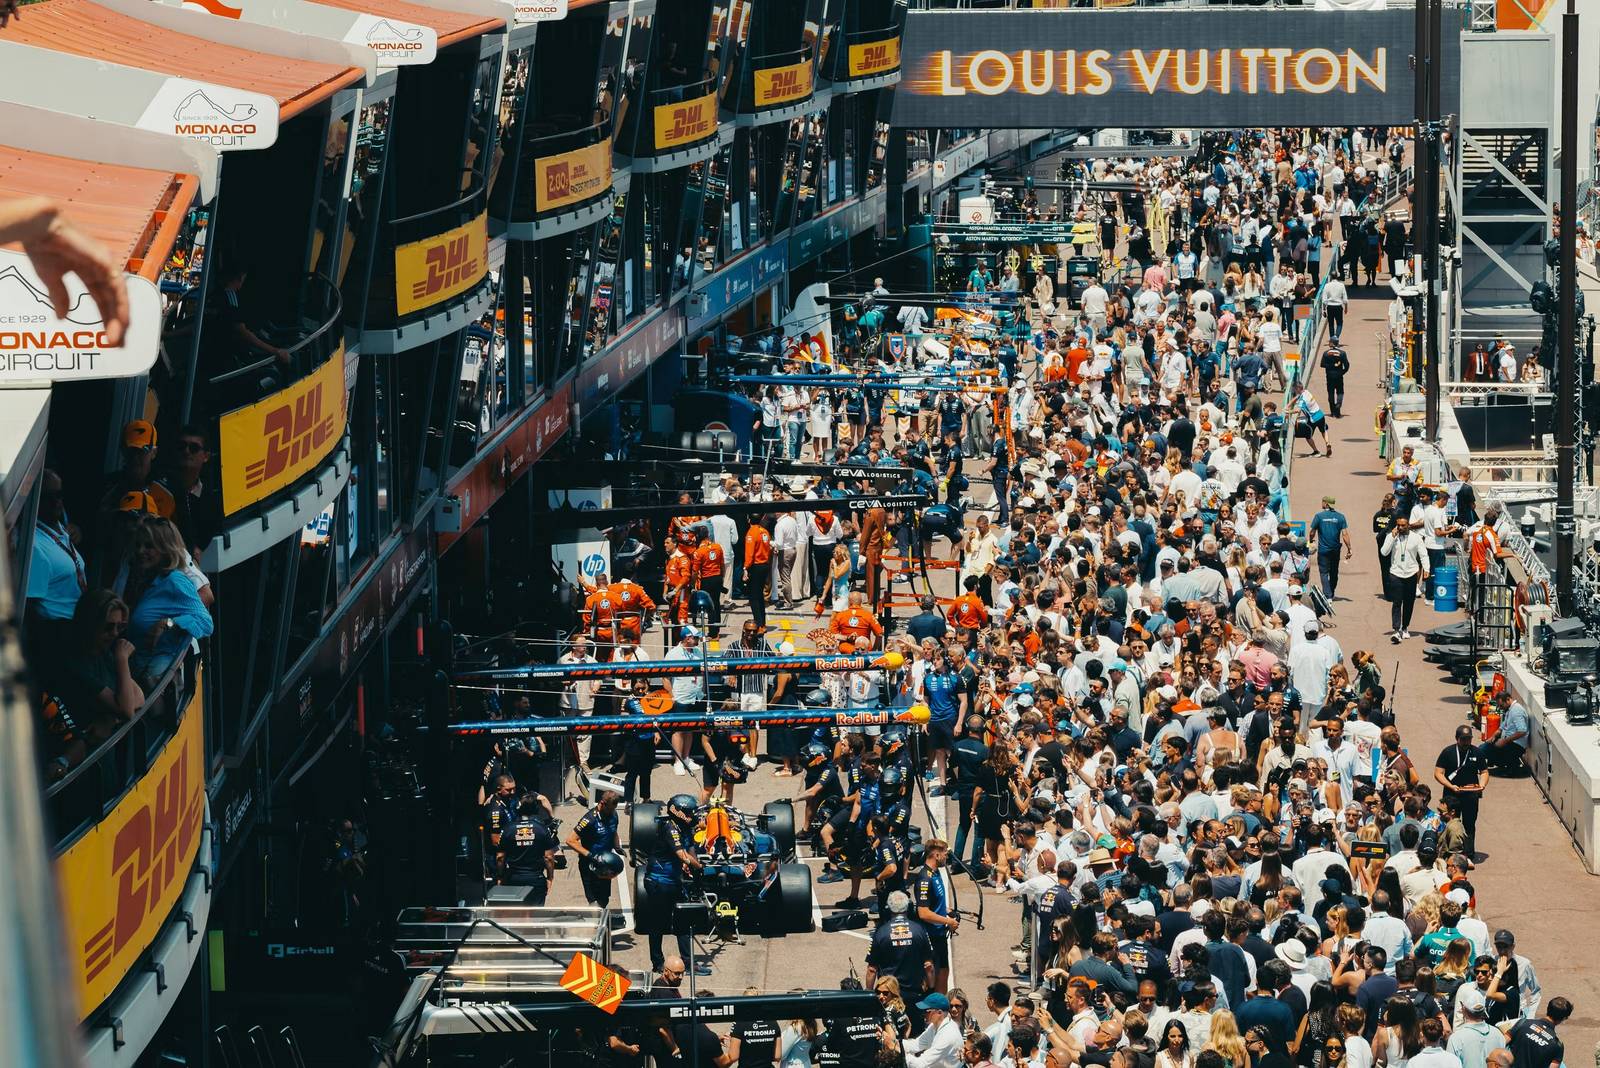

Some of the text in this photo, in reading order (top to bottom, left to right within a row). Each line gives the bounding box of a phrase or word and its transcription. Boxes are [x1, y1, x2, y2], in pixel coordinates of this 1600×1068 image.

[863, 45, 891, 70] DHL
[941, 47, 1387, 96] LOUIS VUITTON
[770, 70, 803, 99] DHL
[175, 124, 257, 135] MONACO
[672, 104, 709, 140] DHL
[188, 135, 247, 146] RCUIT
[425, 233, 478, 297] DHL
[19, 315, 47, 323] 1929
[0, 353, 101, 371] IRCUIT
[262, 382, 334, 482] DHL
[584, 553, 606, 577] hp
[110, 736, 199, 958] DHL
[669, 1005, 735, 1018] Einhell
[743, 1029, 776, 1037] PETRONAS
[846, 1023, 879, 1033] PETRONA
